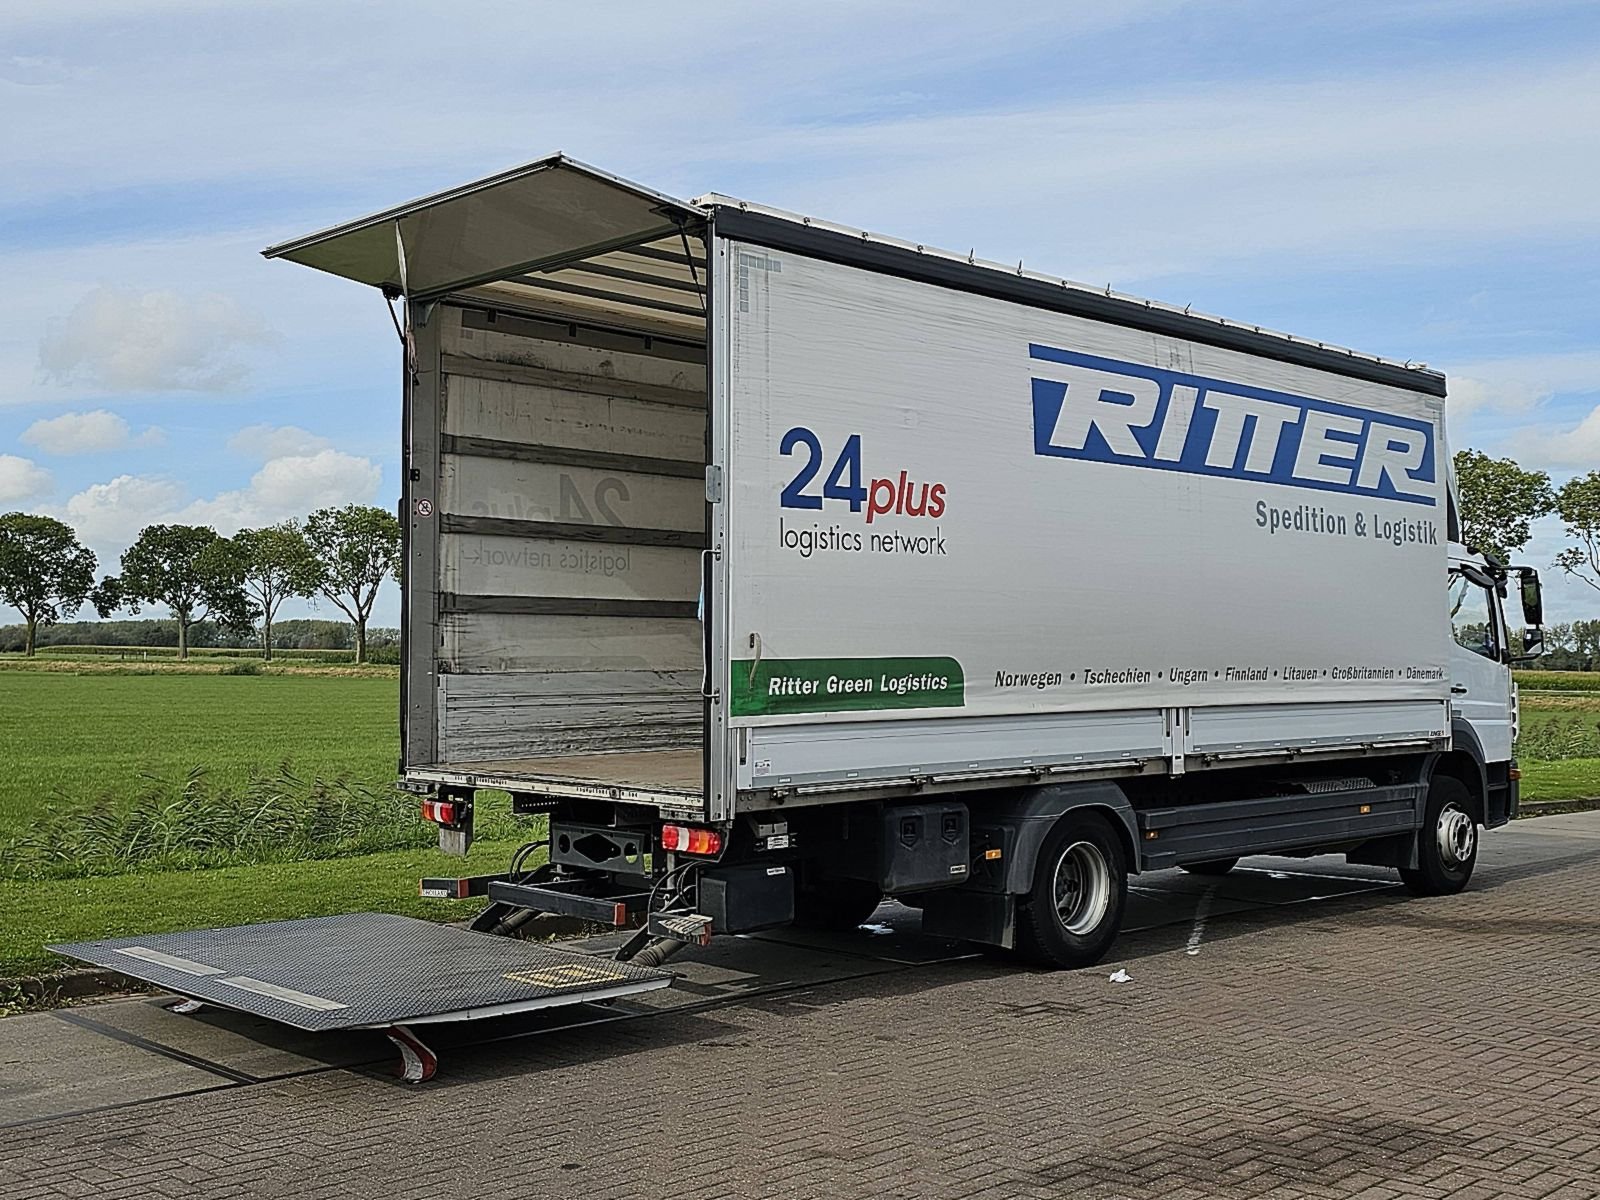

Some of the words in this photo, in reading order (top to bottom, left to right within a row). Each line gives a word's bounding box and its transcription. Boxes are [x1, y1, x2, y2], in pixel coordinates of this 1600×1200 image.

[1030, 354, 1436, 500] RITTER
[779, 427, 947, 524] 24plus
[780, 517, 862, 558] logistics
[870, 527, 947, 555] network
[1255, 500, 1346, 535] Spedition
[1353, 517, 1367, 537] &
[1373, 514, 1438, 546] Logistik
[768, 677, 820, 696] Ritter
[826, 675, 873, 693] Green
[880, 673, 948, 695] Logistics
[995, 670, 1062, 689] Norwegen
[1084, 668, 1150, 685] Tschechien
[1169, 667, 1208, 685] Ungarn
[1225, 667, 1268, 681] Finnland
[1283, 667, 1318, 681] Litauen
[1331, 666, 1394, 681] Großbritannien
[1406, 667, 1444, 680] Dänemark
